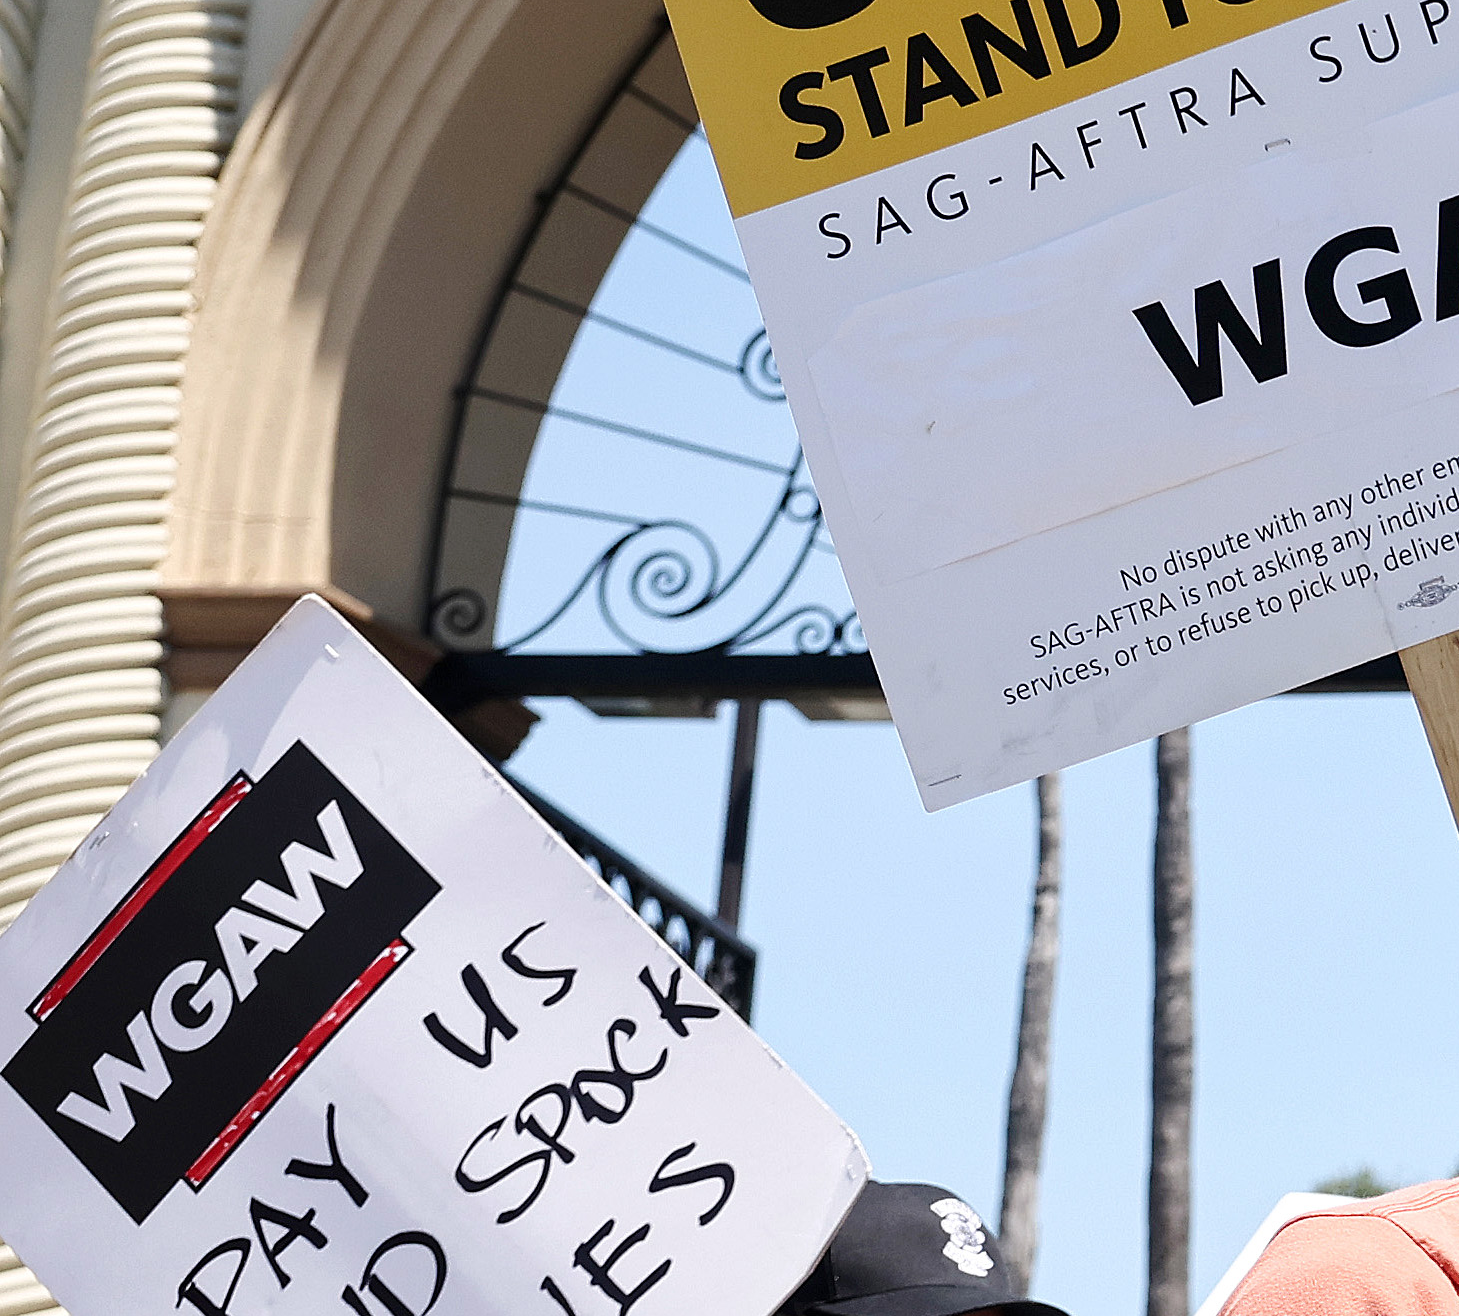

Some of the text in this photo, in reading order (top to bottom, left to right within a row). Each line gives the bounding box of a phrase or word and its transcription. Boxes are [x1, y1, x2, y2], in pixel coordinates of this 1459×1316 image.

[817, 66, 1266, 260] SAG-AFTRA
[1031, 593, 1176, 658] SAG-AFTRA
[1180, 586, 1200, 607] is
[1207, 568, 1248, 598] not
[1253, 542, 1328, 581] asking
[1331, 525, 1370, 553] any
[1120, 566, 1157, 591] No
[1164, 533, 1250, 575] dispute
[1255, 508, 1307, 542] with
[1313, 494, 1351, 522] any
[1361, 469, 1423, 504] other
[1004, 659, 1109, 704] services,
[1115, 645, 1138, 666] or
[1145, 636, 1171, 655] to
[1178, 607, 1251, 645] refuse
[1256, 597, 1282, 616] to
[1289, 572, 1336, 612] pick
[1341, 564, 1378, 588] up,
[57, 800, 366, 1143] WGAW
[422, 921, 578, 1069] US
[455, 965, 720, 1226] SPOCK
